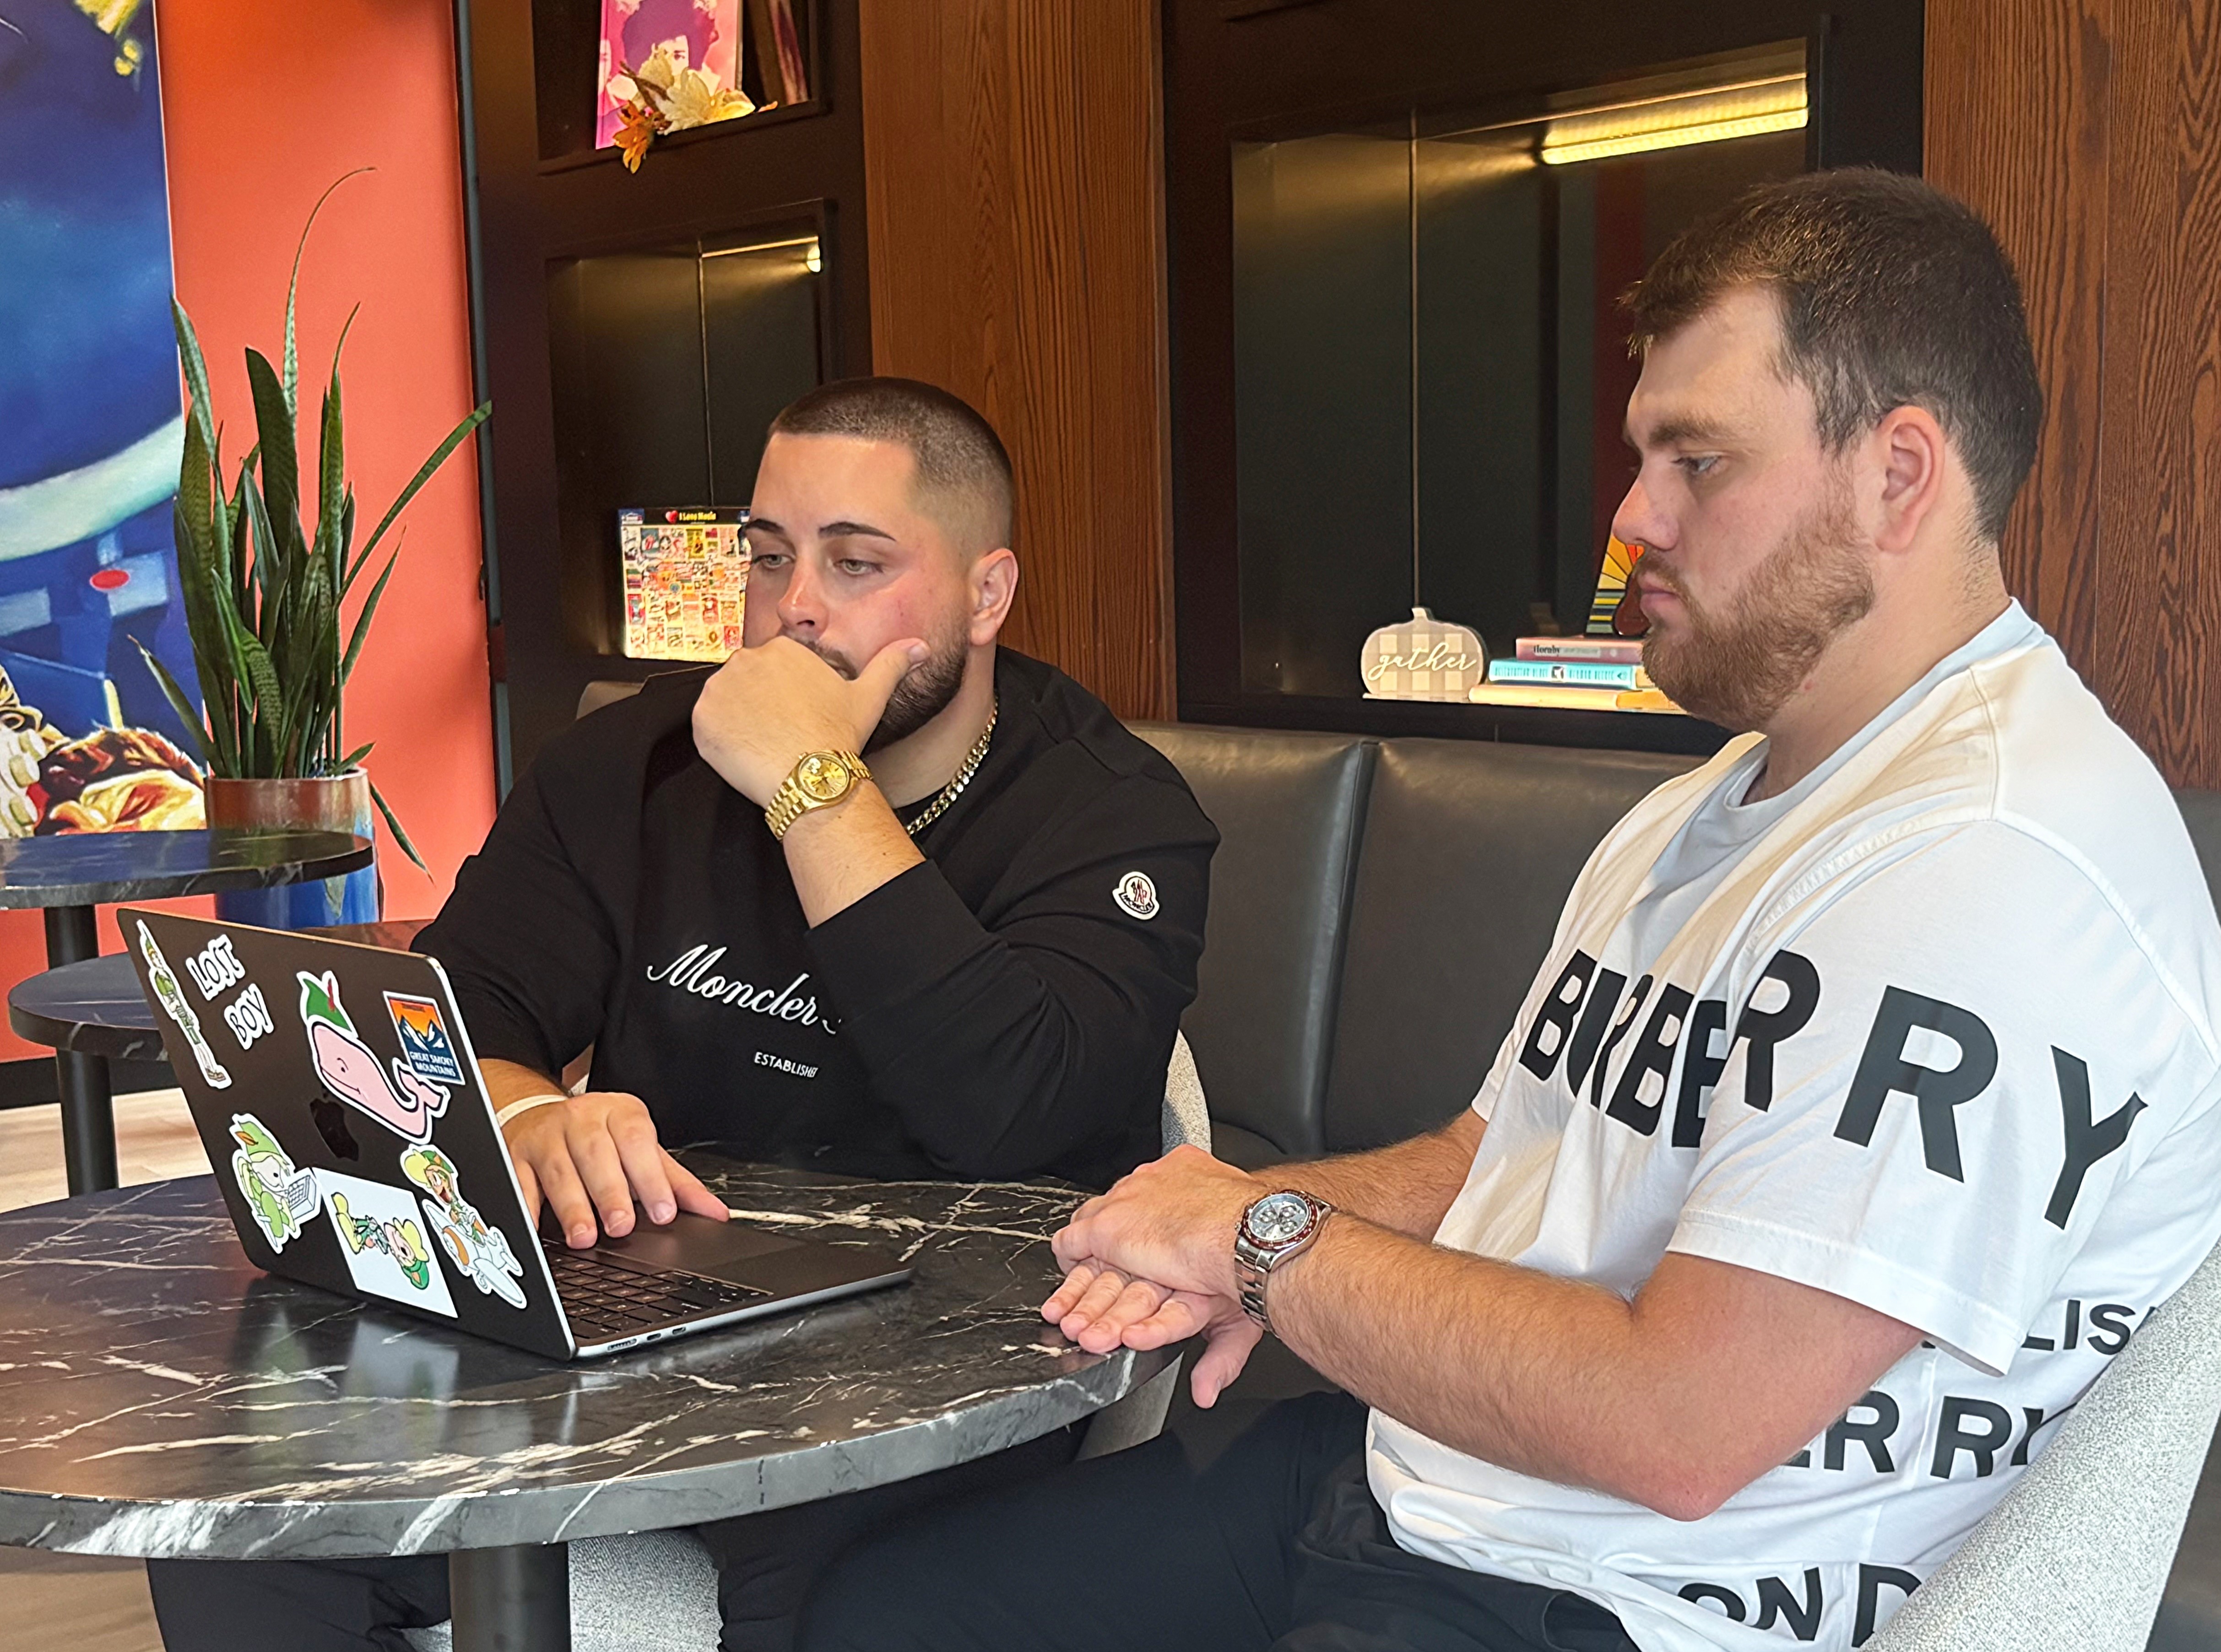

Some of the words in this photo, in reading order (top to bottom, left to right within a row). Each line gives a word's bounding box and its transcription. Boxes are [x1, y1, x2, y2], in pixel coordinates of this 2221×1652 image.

[1368, 642, 1477, 681] gather
[190, 941, 241, 994] LOST
[229, 990, 269, 1043] BOY
[409, 1051, 429, 1062] GREAT
[429, 1054, 454, 1067] SMOKY
[415, 1061, 456, 1077] MOUNTAINS
